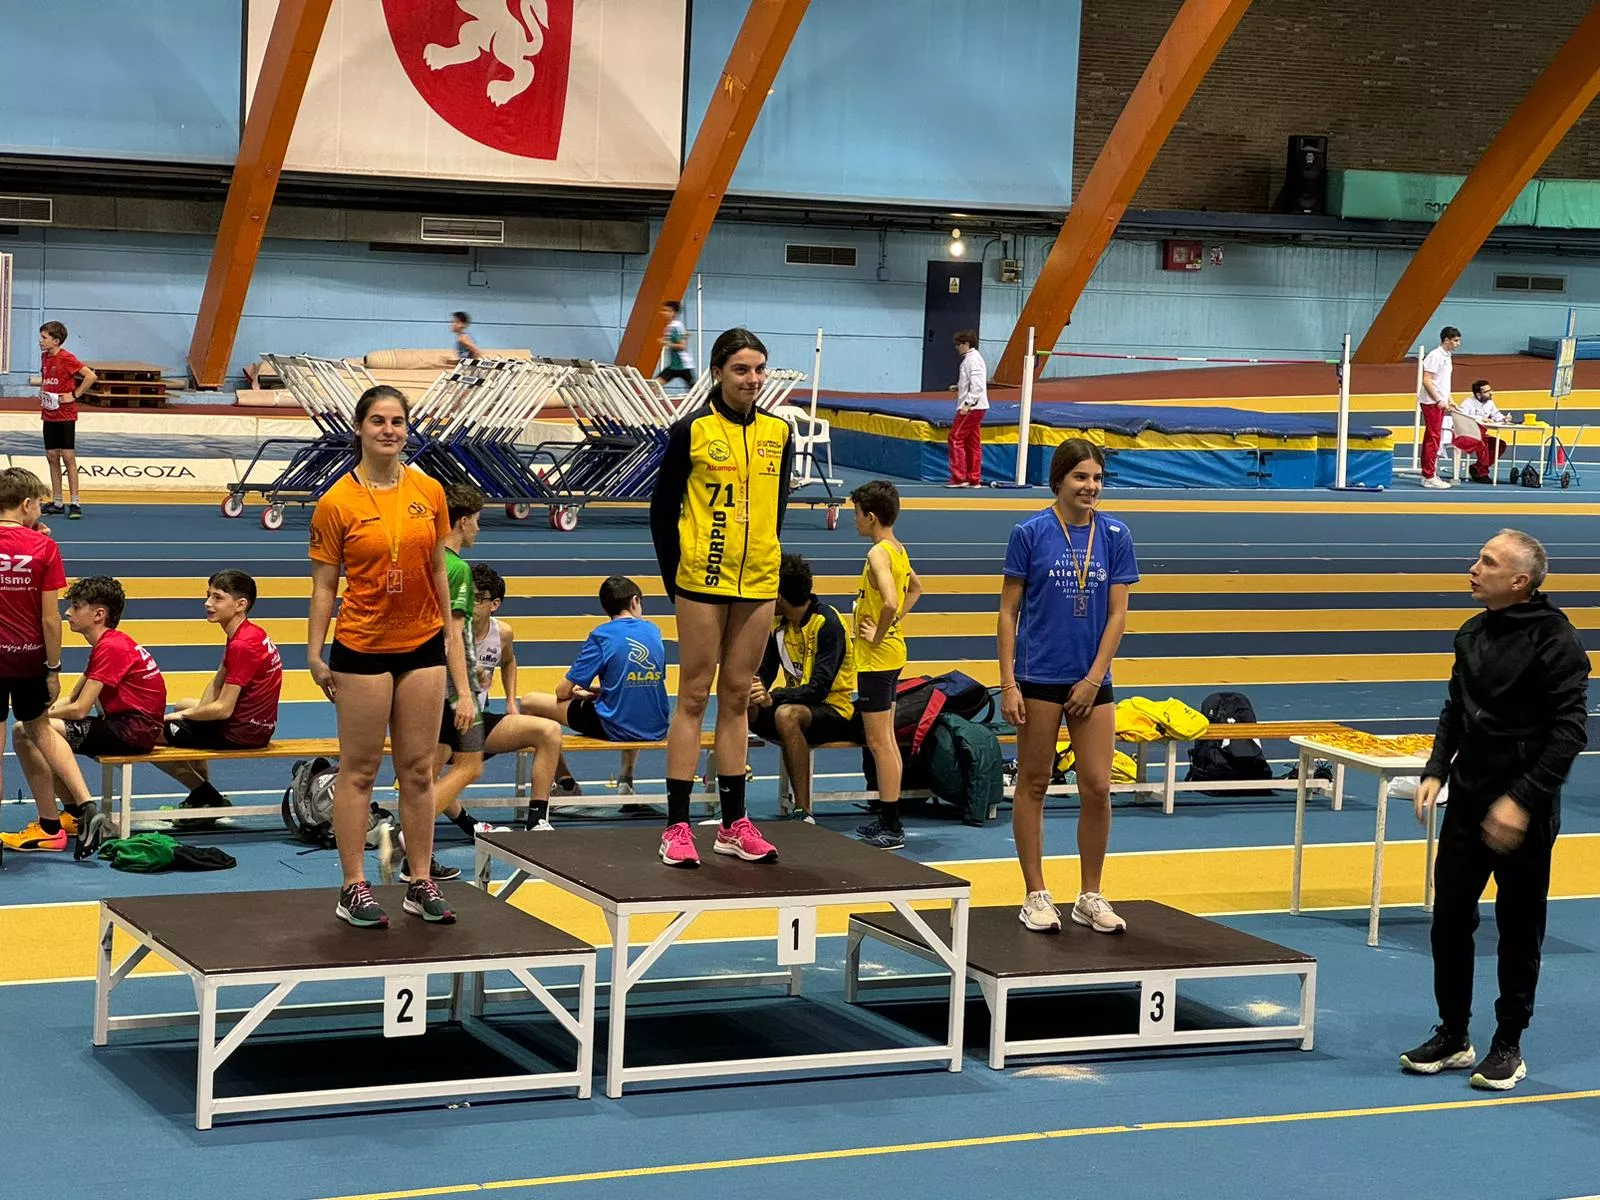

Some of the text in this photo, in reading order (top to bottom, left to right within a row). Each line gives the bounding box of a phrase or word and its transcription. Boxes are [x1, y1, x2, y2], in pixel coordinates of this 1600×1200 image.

[706, 464, 737, 473] Alcampo
[705, 483, 736, 508] 71
[704, 510, 727, 587] SCORPIO
[627, 671, 662, 682] ALAS
[791, 918, 800, 951] 1
[396, 988, 414, 1024] 2
[1150, 990, 1165, 1023] 3
